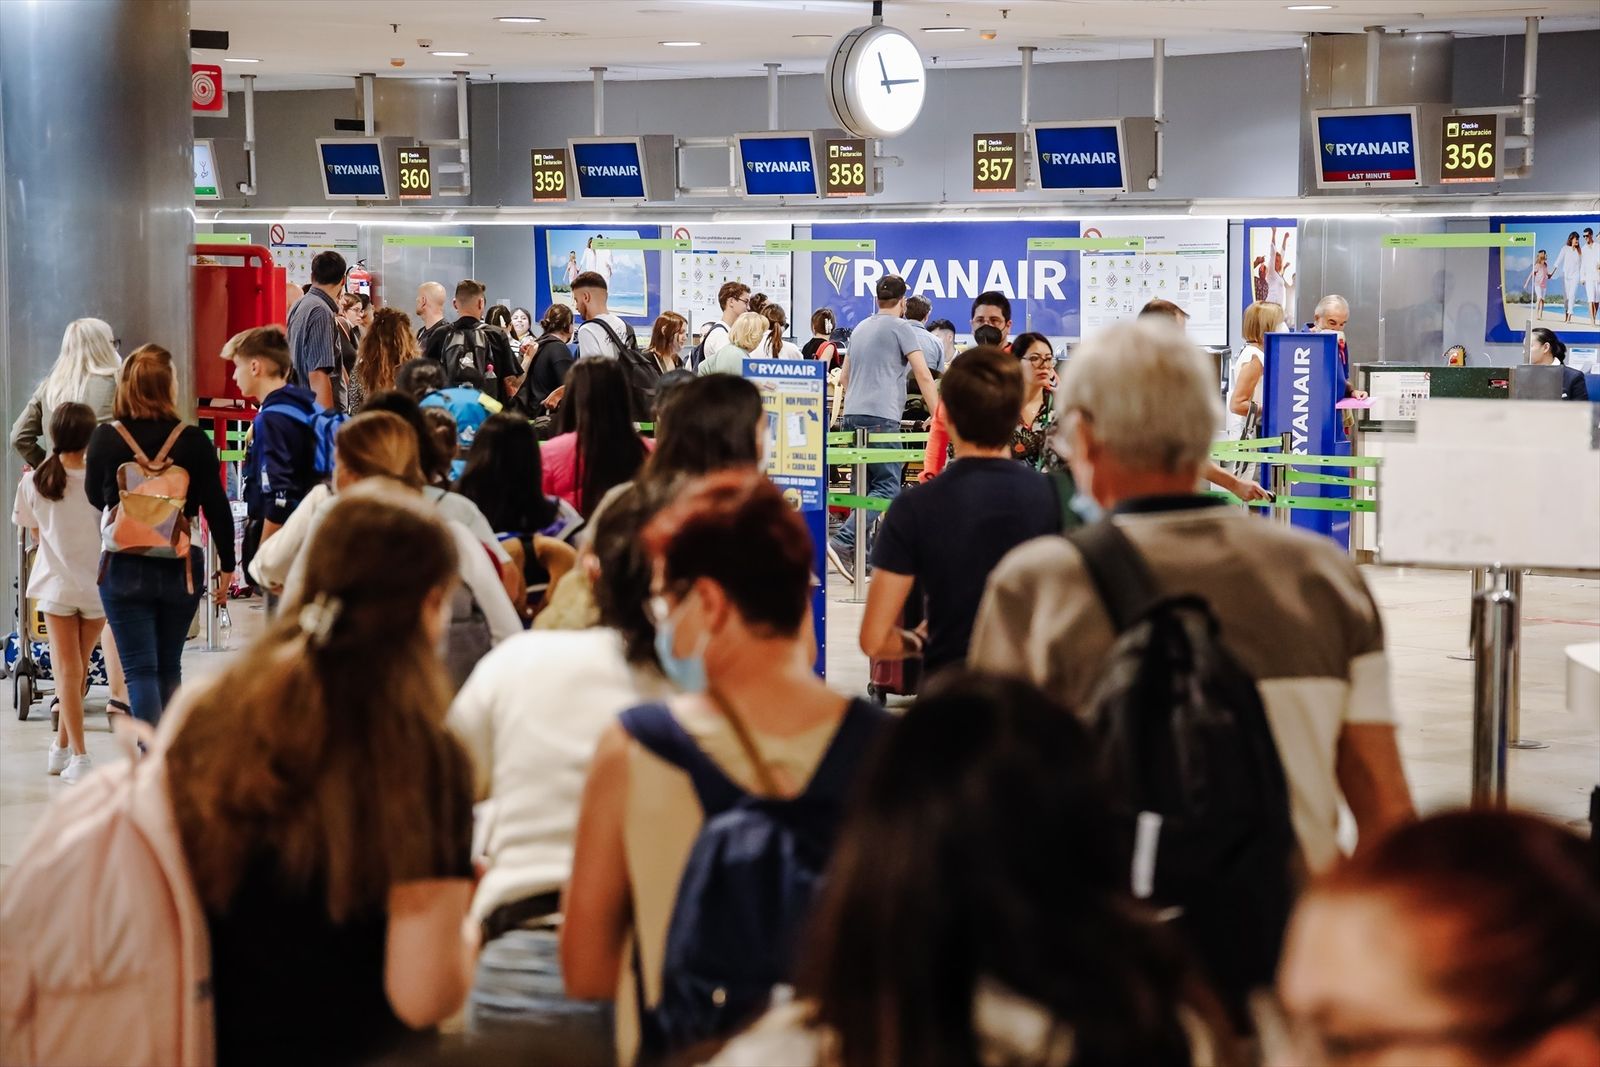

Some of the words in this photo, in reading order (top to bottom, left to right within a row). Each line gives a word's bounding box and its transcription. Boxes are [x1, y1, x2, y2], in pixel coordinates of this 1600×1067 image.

[1335, 141, 1410, 156] RYANAIR
[1051, 152, 1117, 165] RYANAIR
[1445, 143, 1493, 170] 356
[334, 164, 380, 175] RYANAIR
[587, 165, 638, 177] RYANAIR
[755, 160, 811, 173] RYANAIR
[977, 158, 1014, 181] 357
[400, 168, 429, 189] 360
[534, 170, 564, 192] 359
[829, 163, 864, 186] 358
[1365, 172, 1391, 180] MINUTE
[758, 363, 816, 376] RYANAIR
